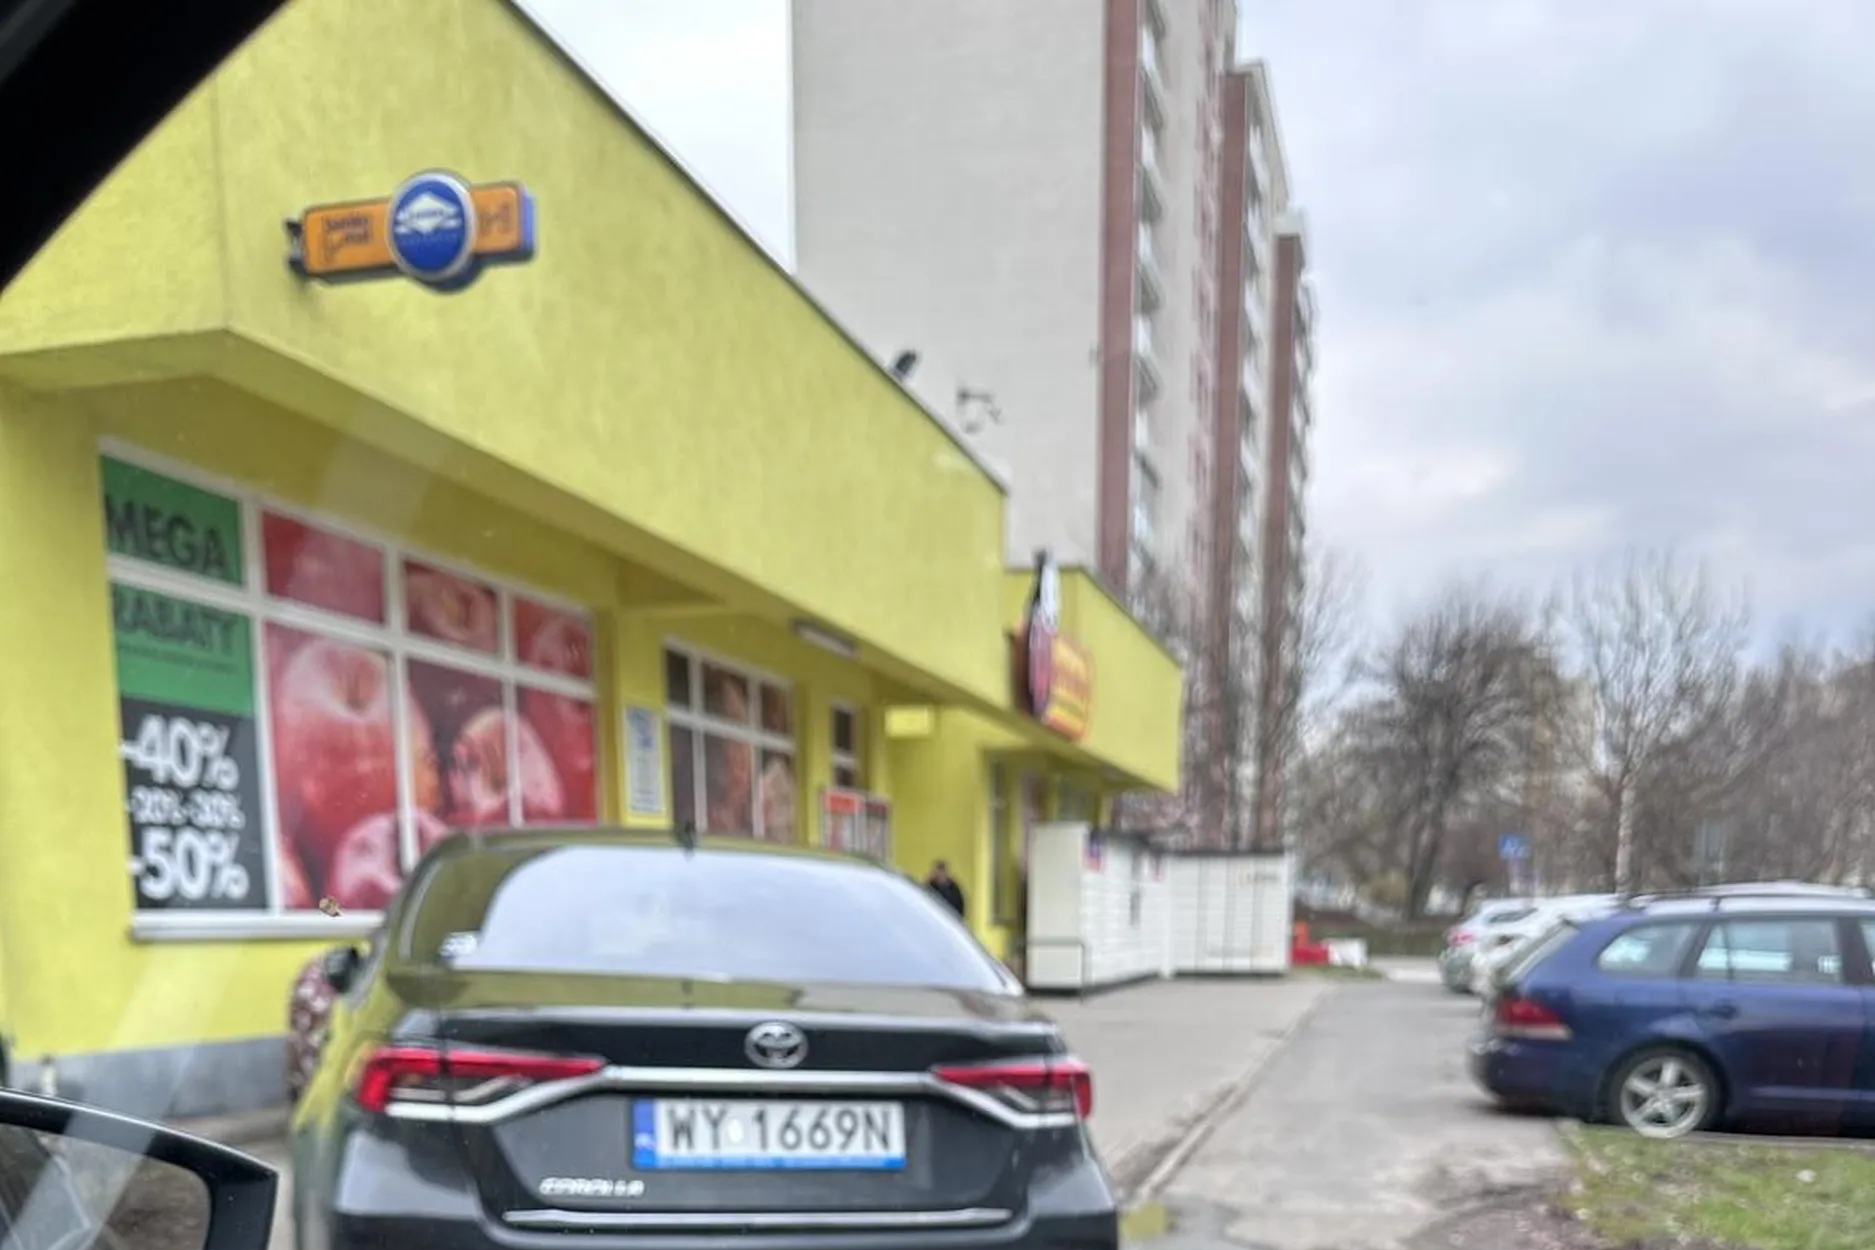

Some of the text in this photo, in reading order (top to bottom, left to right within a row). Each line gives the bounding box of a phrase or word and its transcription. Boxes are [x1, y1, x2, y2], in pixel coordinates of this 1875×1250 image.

[105, 496, 231, 581] MEGA
[120, 714, 240, 792] -40%
[128, 826, 249, 900] -50%
[668, 1108, 890, 1152] WY 1669N
